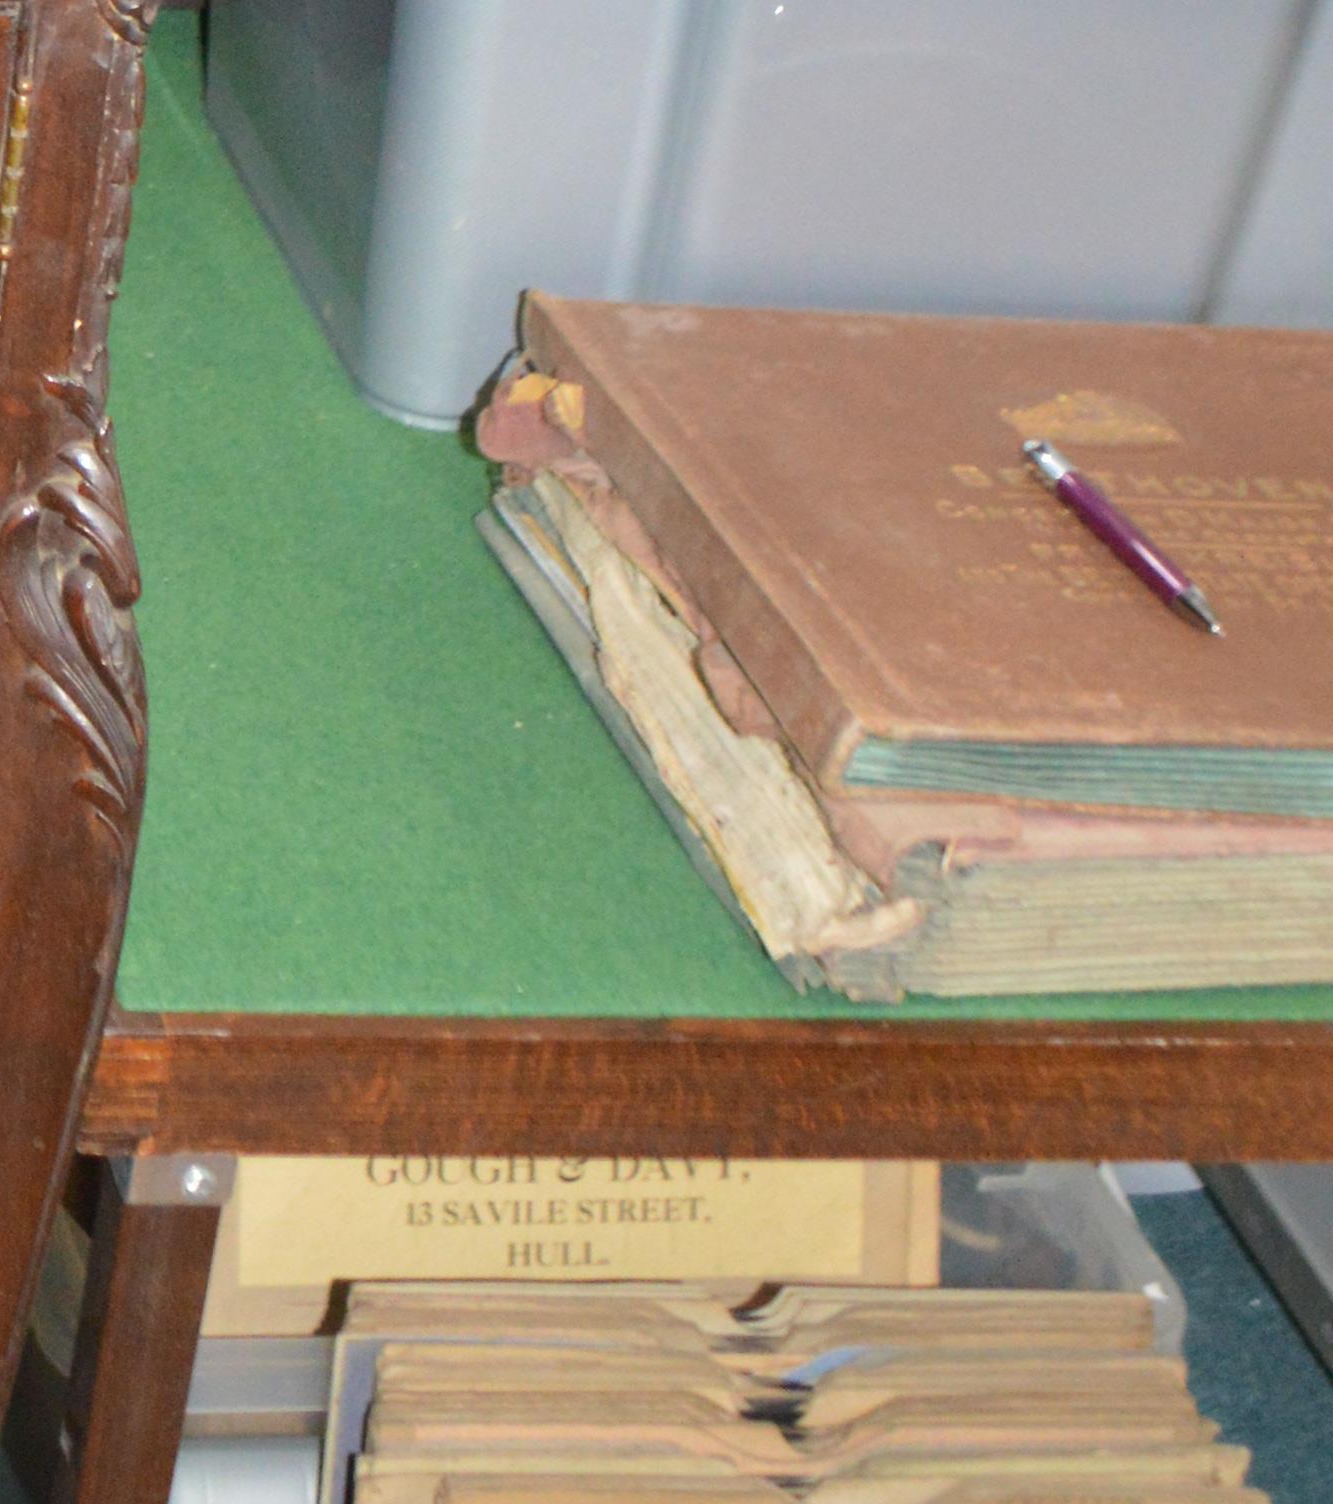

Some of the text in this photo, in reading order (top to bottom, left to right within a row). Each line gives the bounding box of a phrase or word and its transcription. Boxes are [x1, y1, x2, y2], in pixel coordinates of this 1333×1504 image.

[366, 1156, 537, 1186] GOUGH
[406, 1202, 434, 1227] 13
[441, 1199, 568, 1226] SAVILE
